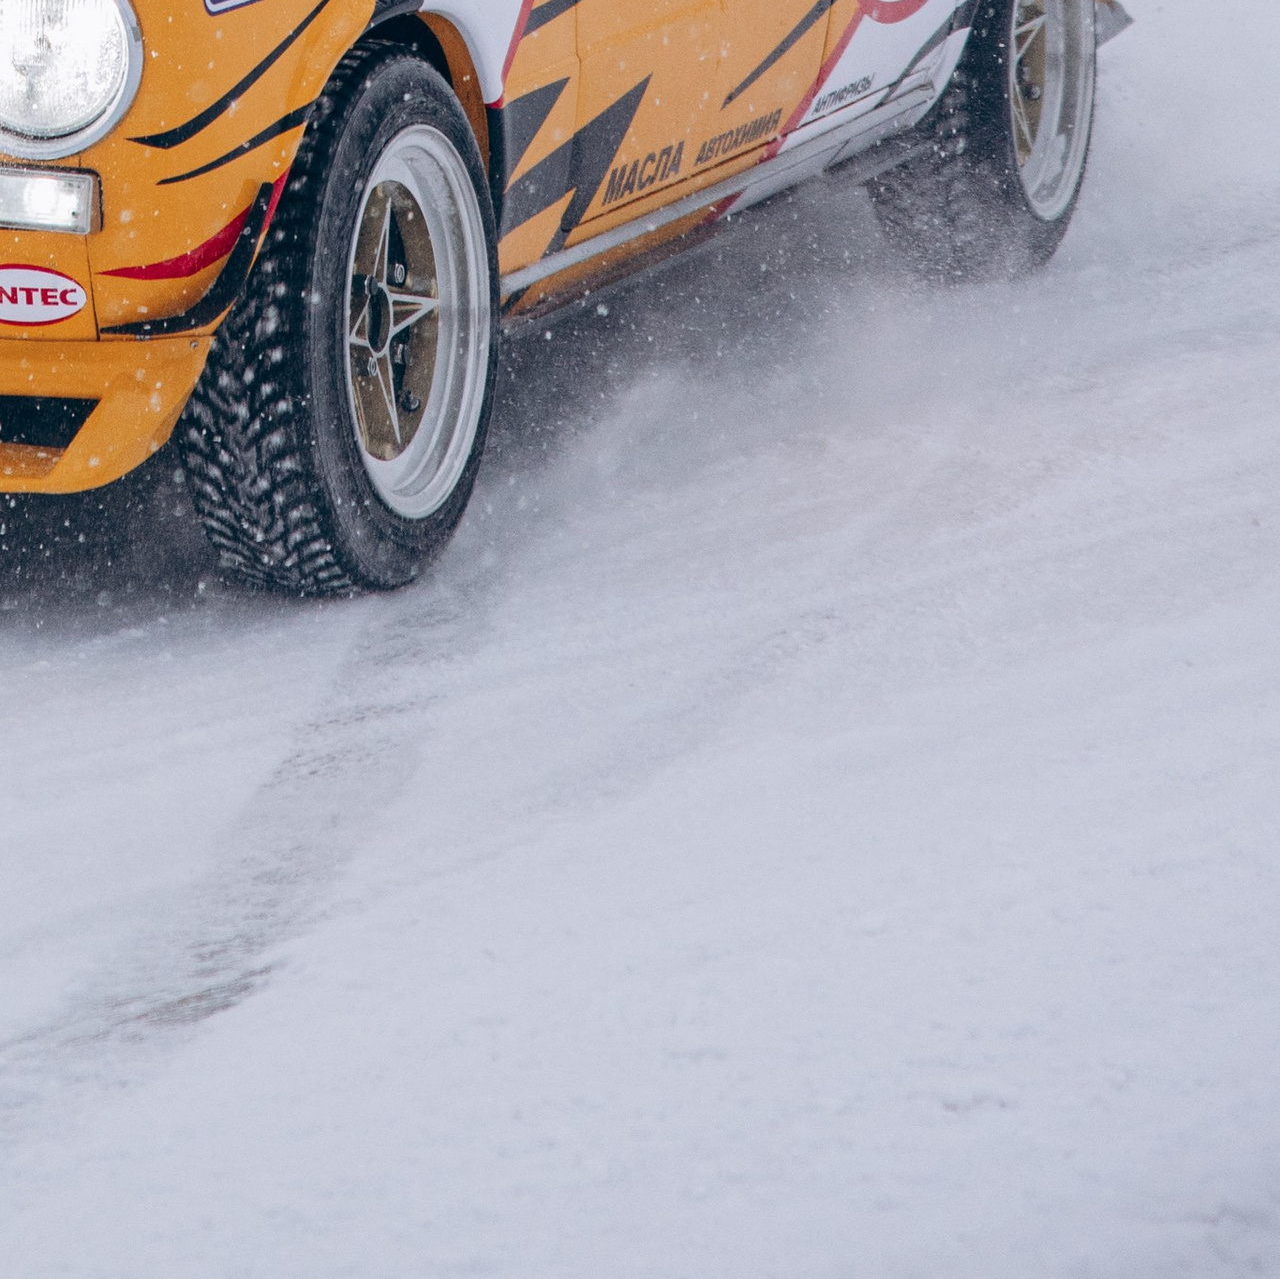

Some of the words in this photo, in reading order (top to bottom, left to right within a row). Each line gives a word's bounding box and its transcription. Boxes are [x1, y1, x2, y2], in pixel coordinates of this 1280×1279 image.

[811, 71, 876, 116] АНТИФРИЗЫ
[601, 140, 685, 207] МАСЛА
[693, 107, 783, 167] АВТОХИМИЯ
